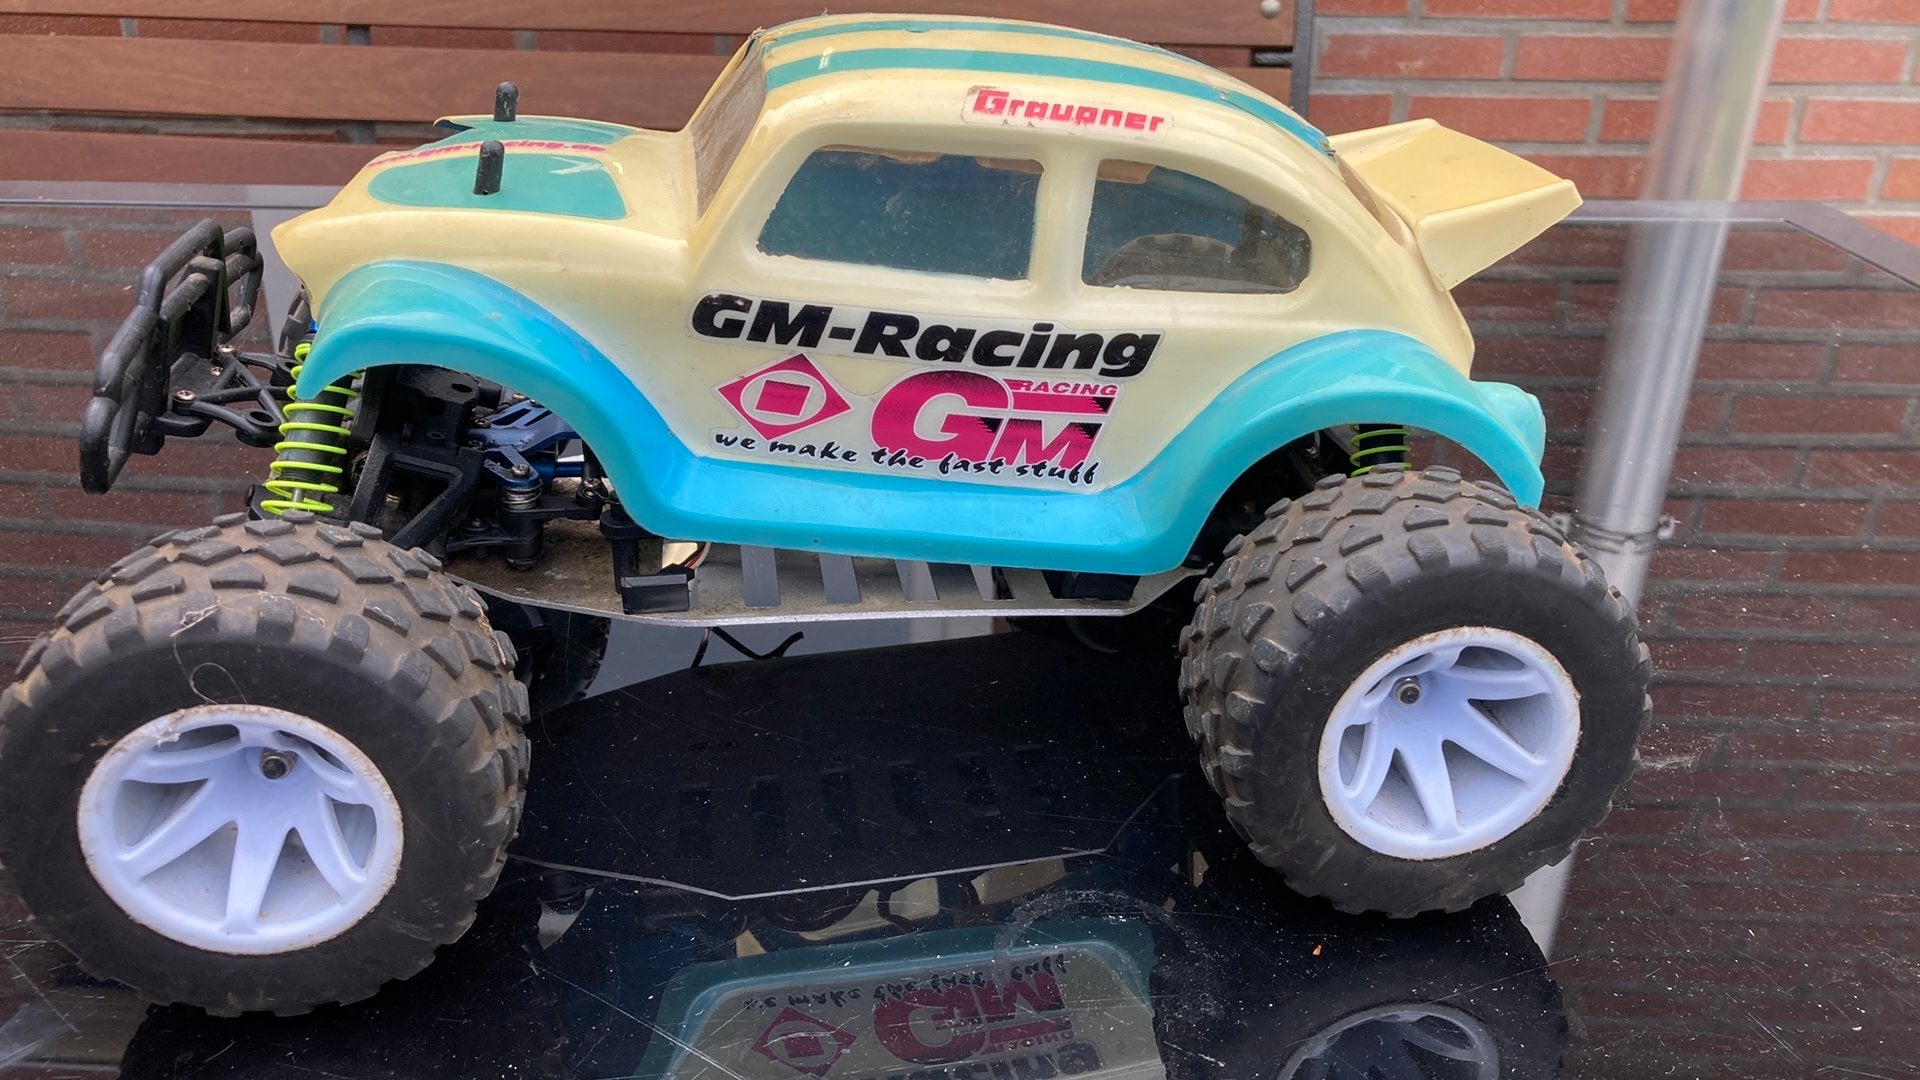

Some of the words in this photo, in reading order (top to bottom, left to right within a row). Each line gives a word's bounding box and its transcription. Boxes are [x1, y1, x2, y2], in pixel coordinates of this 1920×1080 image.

[973, 89, 1165, 132] Graupner
[692, 293, 1163, 376] GM-Racing
[1019, 380, 1118, 397] RACING
[871, 369, 1103, 468] GM
[715, 433, 756, 450] we
[769, 441, 858, 463] make
[871, 447, 924, 468] the
[938, 453, 1004, 475] fast
[1015, 461, 1100, 485] stuff
